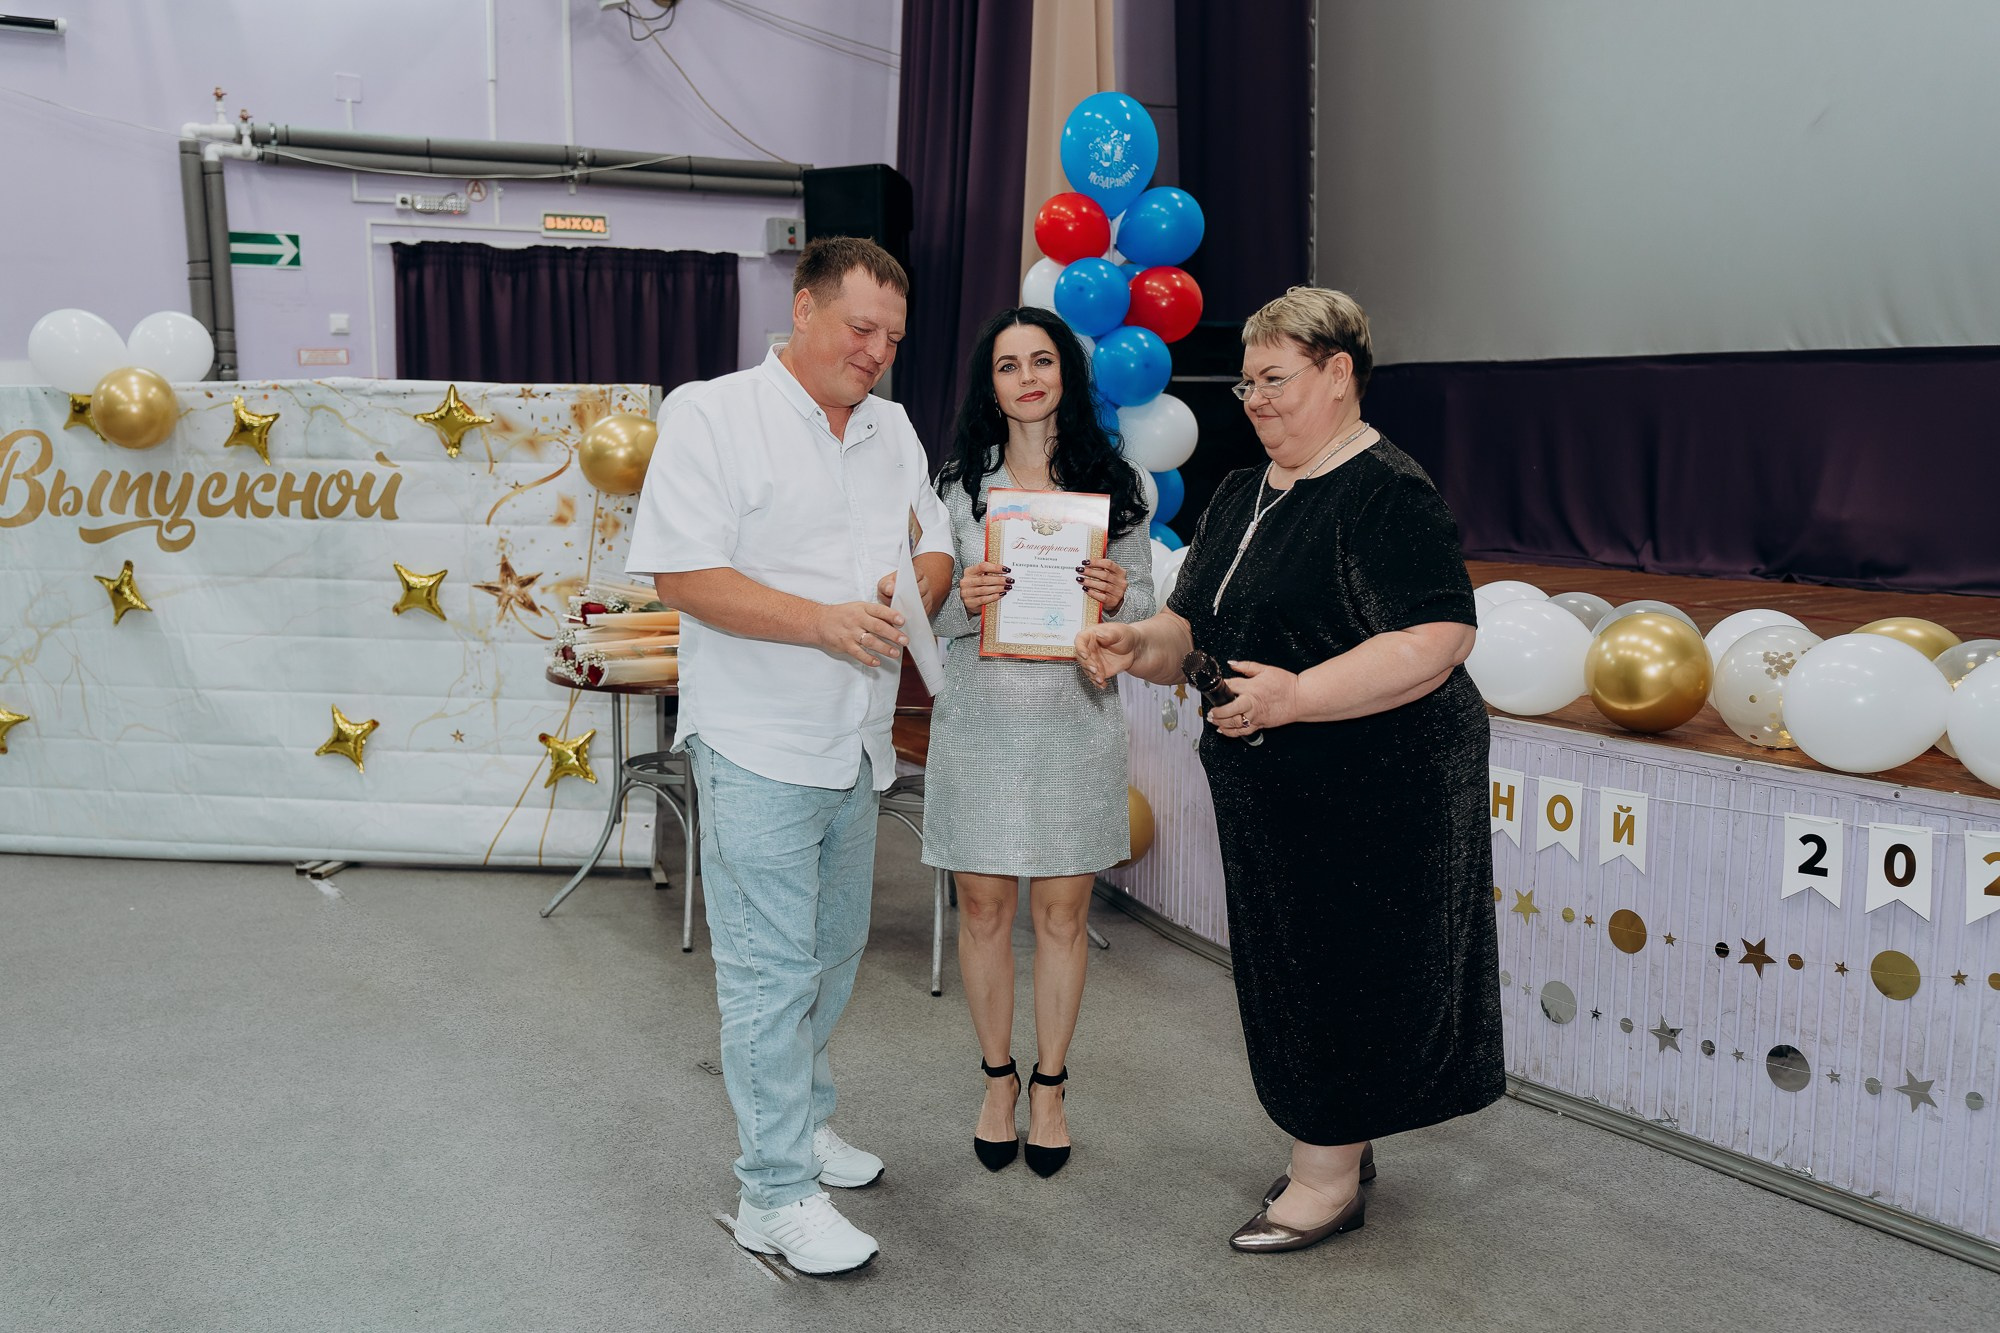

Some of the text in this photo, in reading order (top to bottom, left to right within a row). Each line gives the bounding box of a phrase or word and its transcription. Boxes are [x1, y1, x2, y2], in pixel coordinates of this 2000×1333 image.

[544, 215, 607, 234] ВЫХОД
[0, 429, 402, 553] Выпускной
[1012, 537, 1080, 556] Благодарность
